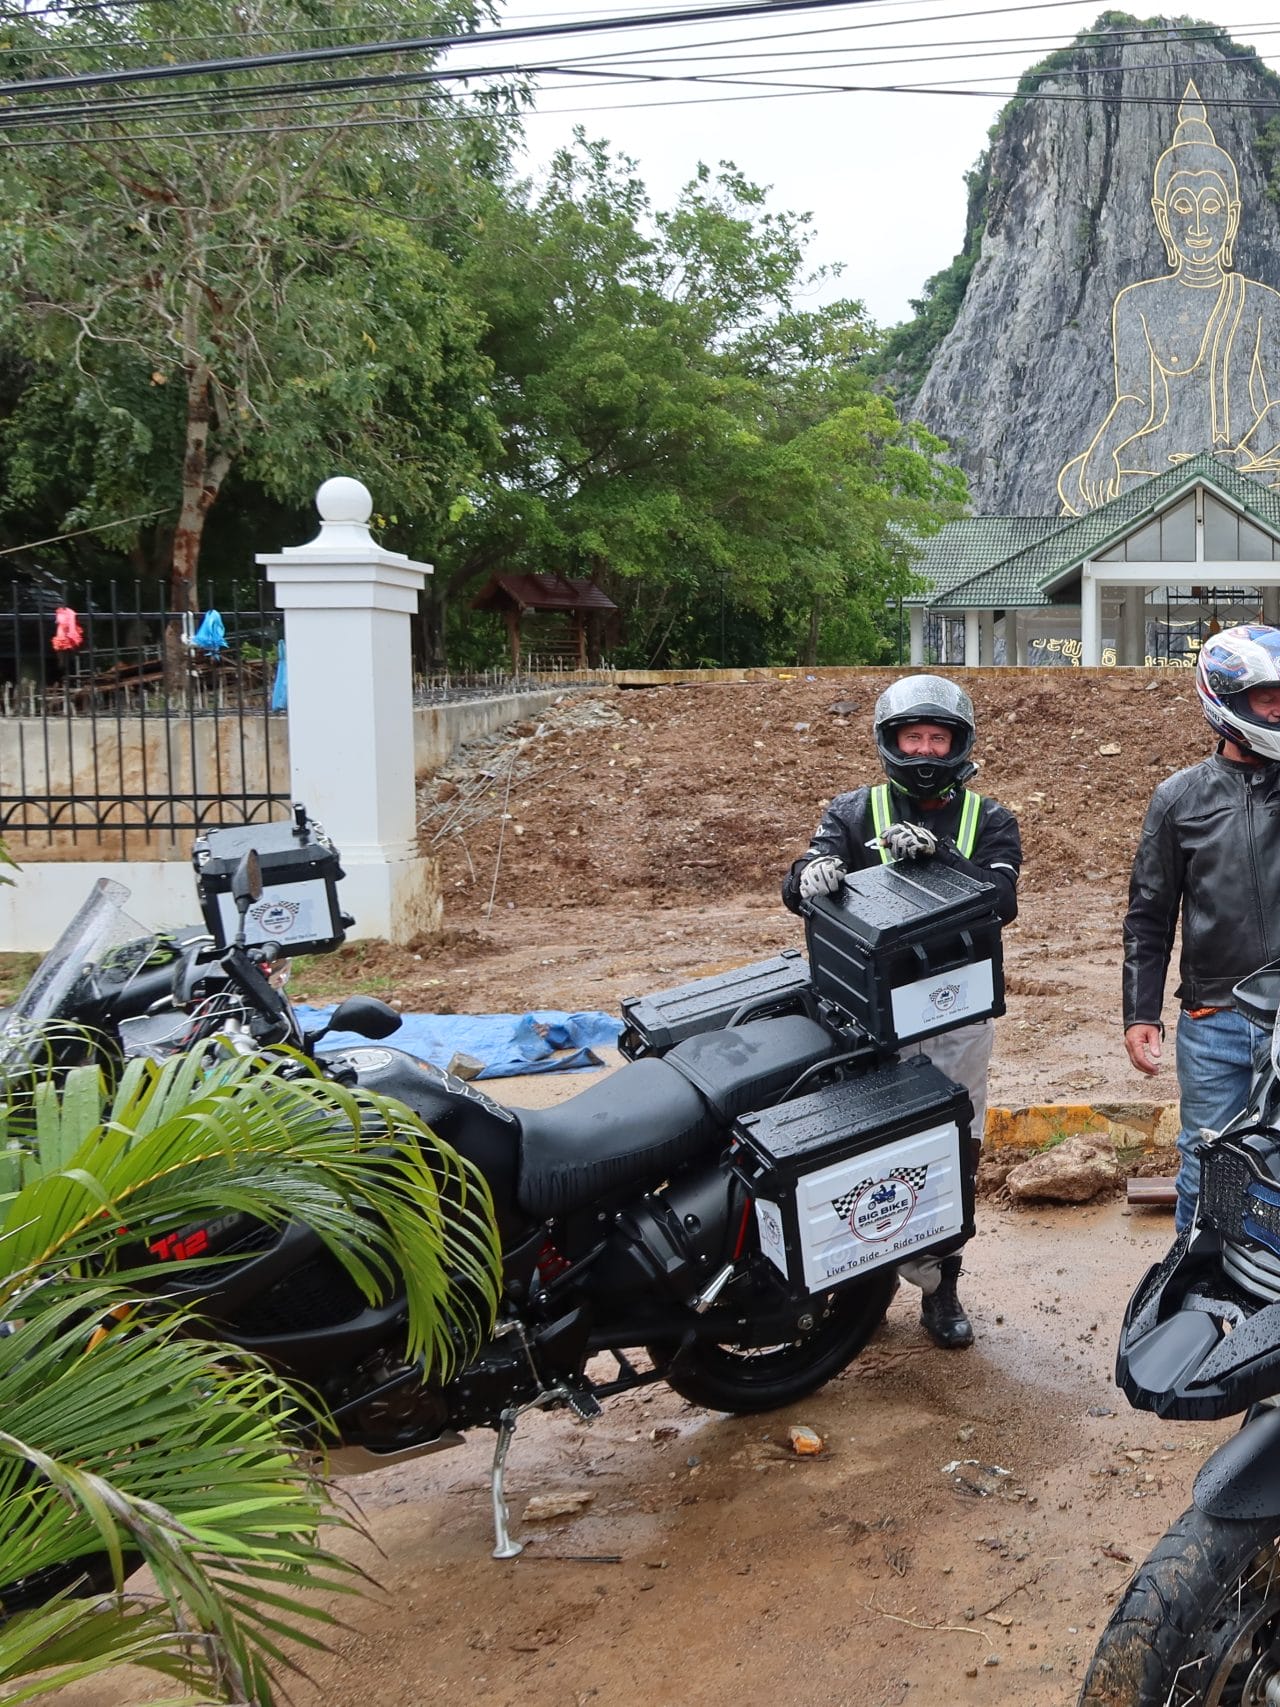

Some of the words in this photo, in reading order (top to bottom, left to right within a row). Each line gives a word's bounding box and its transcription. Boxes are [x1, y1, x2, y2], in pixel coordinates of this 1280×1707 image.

[858, 1211, 879, 1223] BIG
[880, 1198, 909, 1215] BIKE
[826, 1265, 846, 1278] Live
[847, 1260, 858, 1269] To
[859, 1251, 880, 1264] Ride
[893, 1238, 913, 1250] Ride
[914, 1233, 925, 1241] To
[926, 1225, 945, 1237] Live
